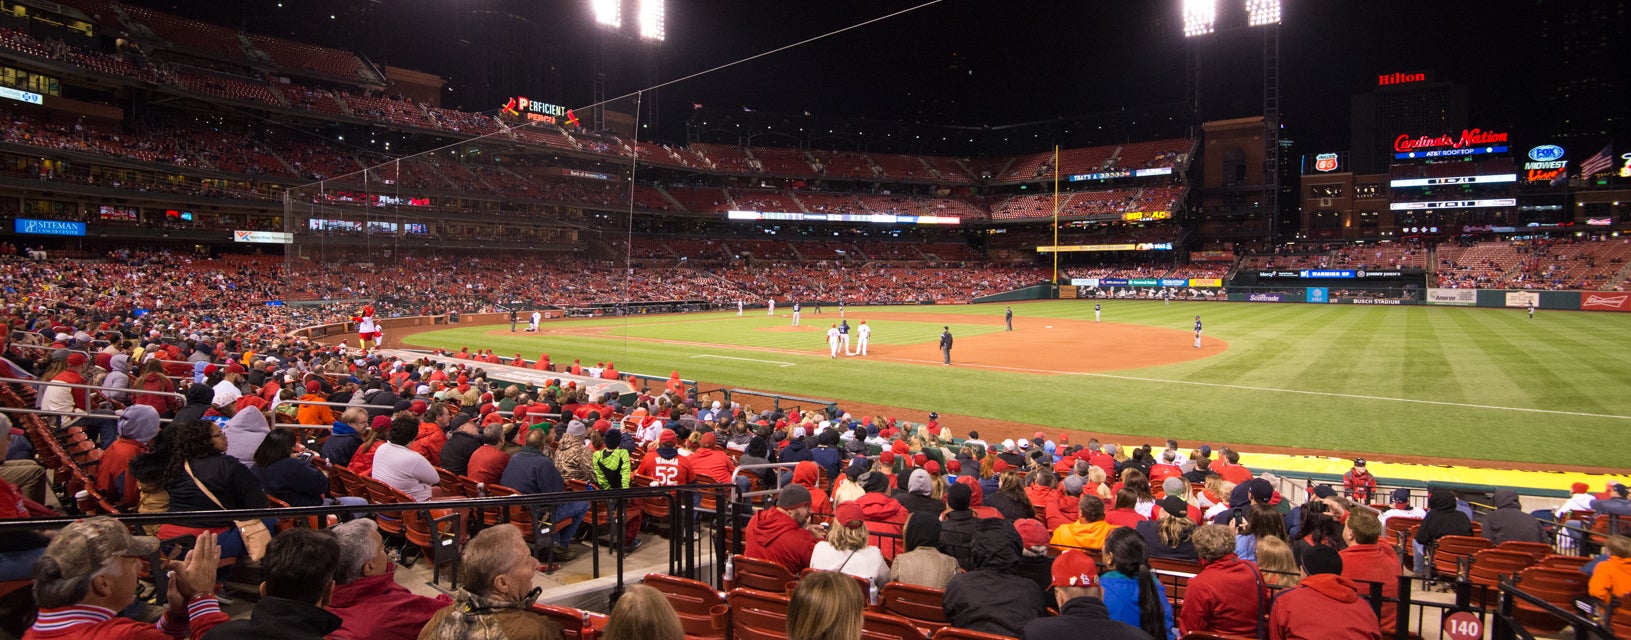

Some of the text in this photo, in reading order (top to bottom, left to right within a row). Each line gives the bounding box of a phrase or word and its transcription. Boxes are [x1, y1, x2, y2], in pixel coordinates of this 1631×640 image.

[1378, 73, 1425, 85] Hilton
[517, 96, 565, 117] PERFICIENT
[1394, 128, 1508, 152] Cardinals Nation
[1442, 148, 1475, 156] ROOFTOP
[1536, 149, 1554, 159] FOX
[1318, 160, 1336, 169] 66
[1524, 160, 1568, 170] MIDWEST
[1126, 212, 1142, 220] BIG
[38, 220, 78, 230] SITEMAN
[655, 466, 678, 485] 52
[1451, 619, 1479, 637] 140
